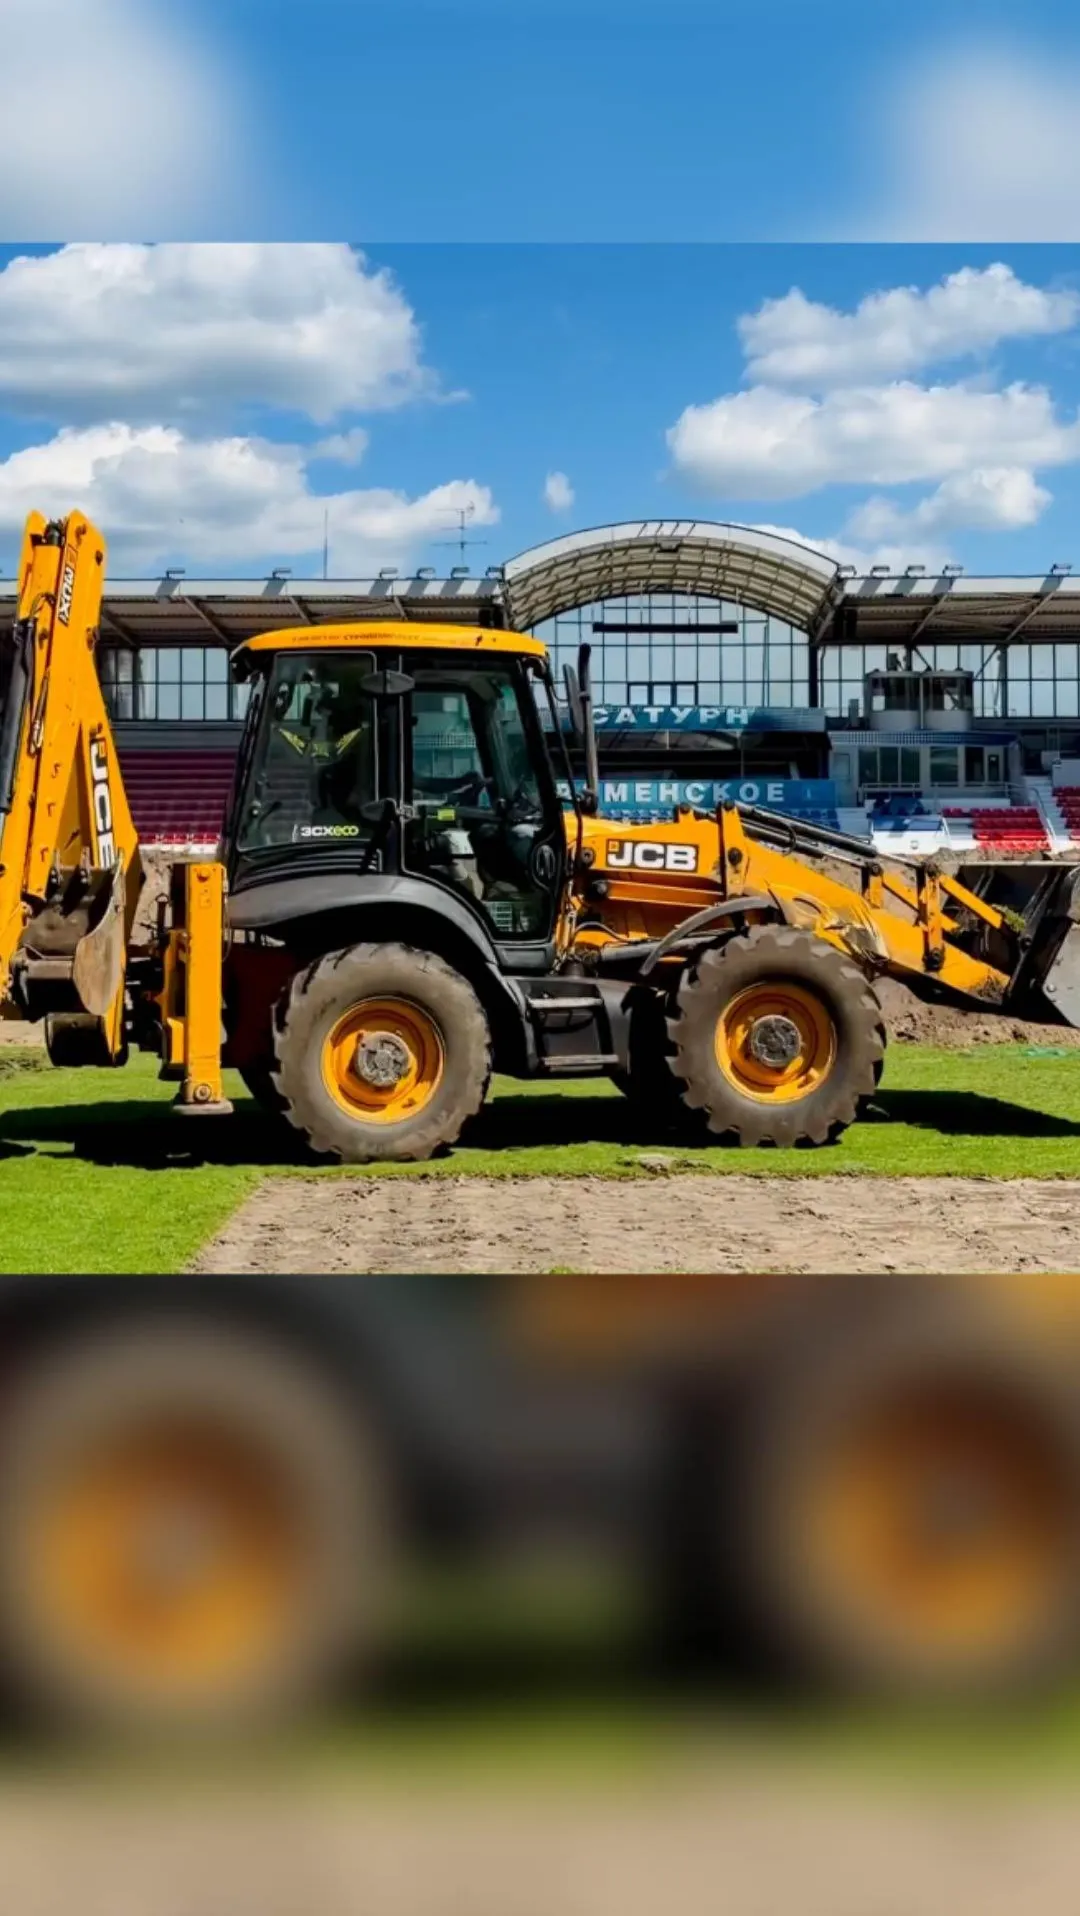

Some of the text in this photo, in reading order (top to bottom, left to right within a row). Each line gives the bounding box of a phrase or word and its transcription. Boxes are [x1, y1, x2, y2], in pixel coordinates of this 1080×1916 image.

[592, 707, 749, 724] САТУРН
[556, 782, 785, 802] РМЕНСКОЕ
[90, 743, 115, 869] JCB
[607, 841, 696, 871] JCB
